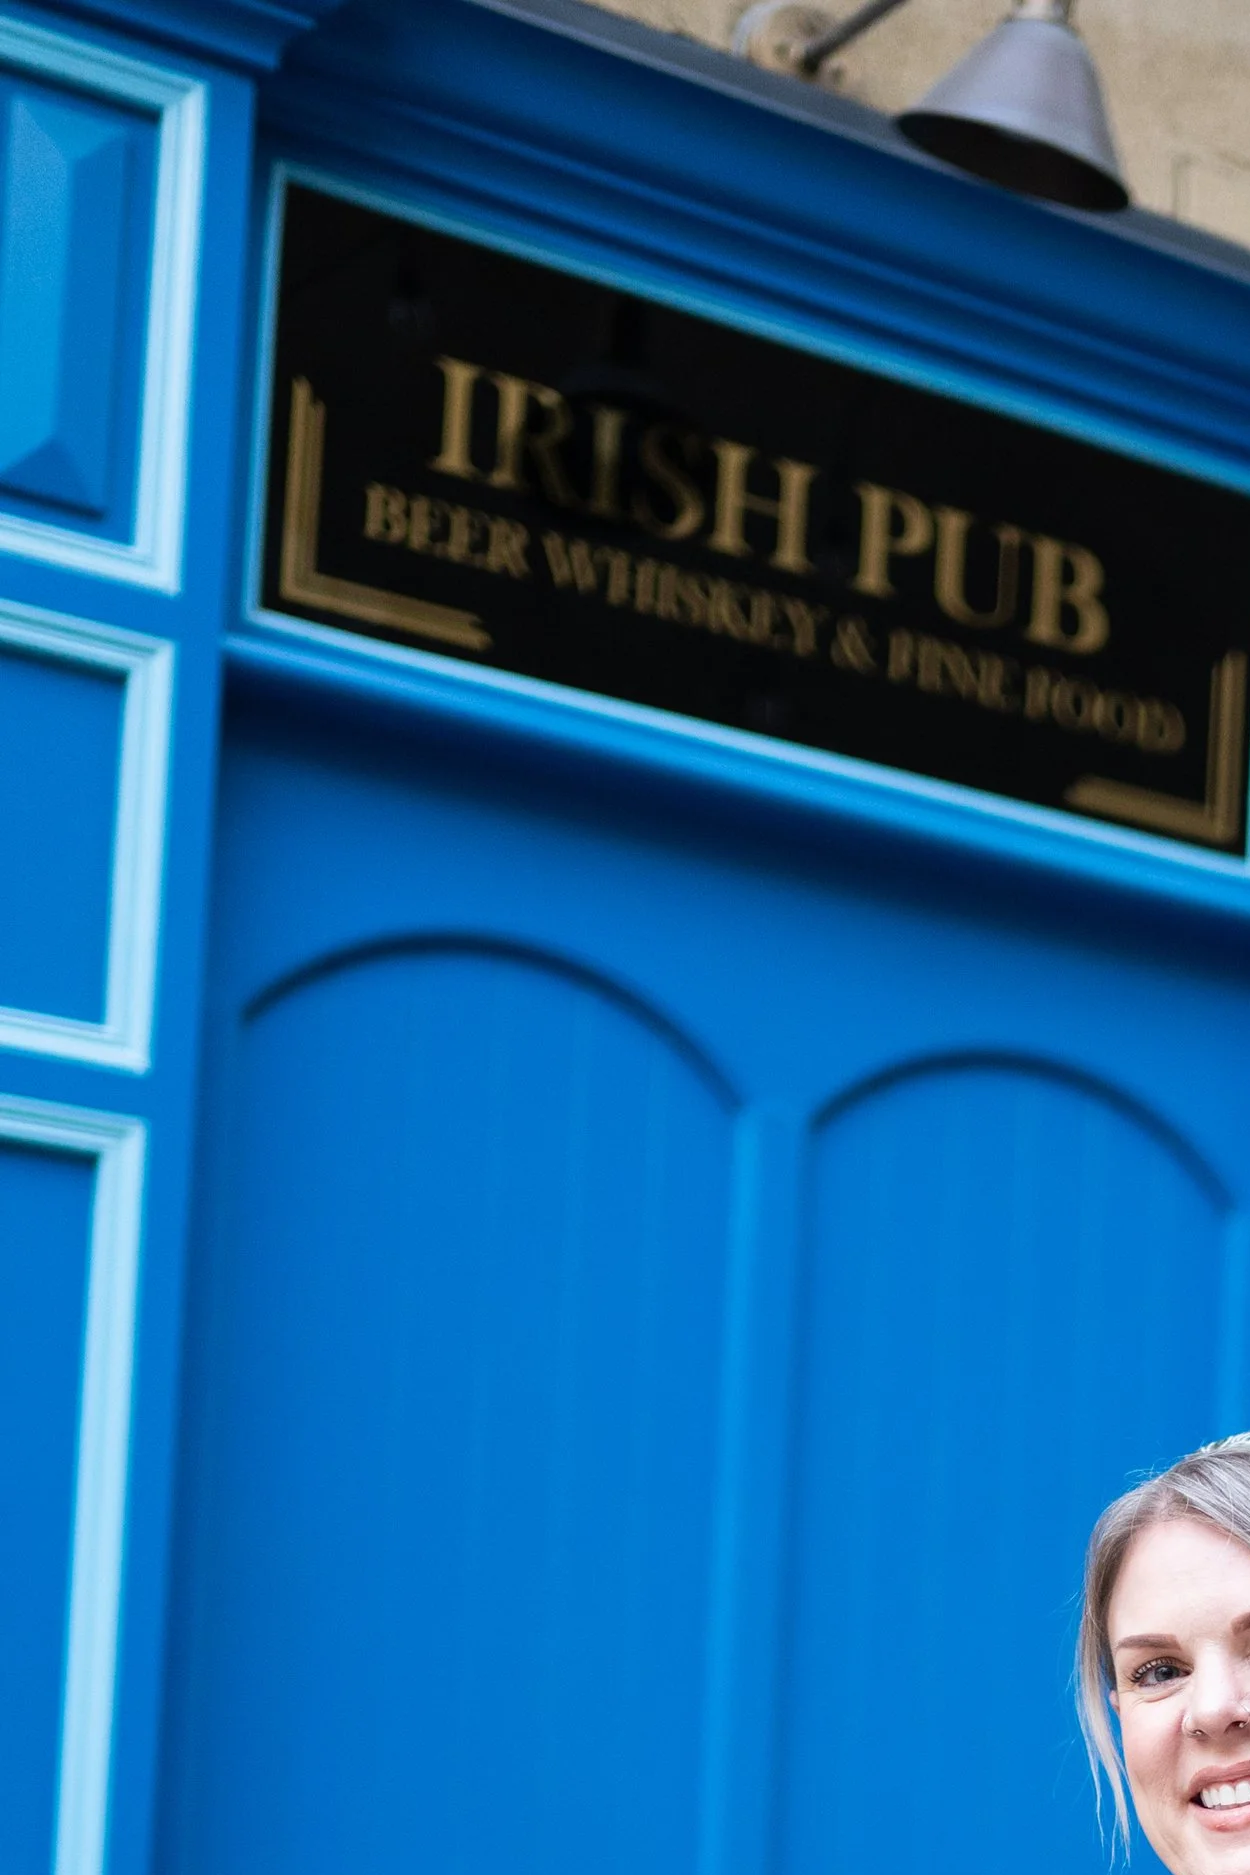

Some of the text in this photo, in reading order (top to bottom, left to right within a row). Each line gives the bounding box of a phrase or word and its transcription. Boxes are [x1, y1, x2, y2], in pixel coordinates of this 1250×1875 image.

[361, 481, 532, 580] BEER
[542, 528, 827, 657] WHISKEY
[829, 614, 876, 674] &
[1022, 662, 1188, 757] FOOD
[430, 356, 1112, 657] IRISH PUB
